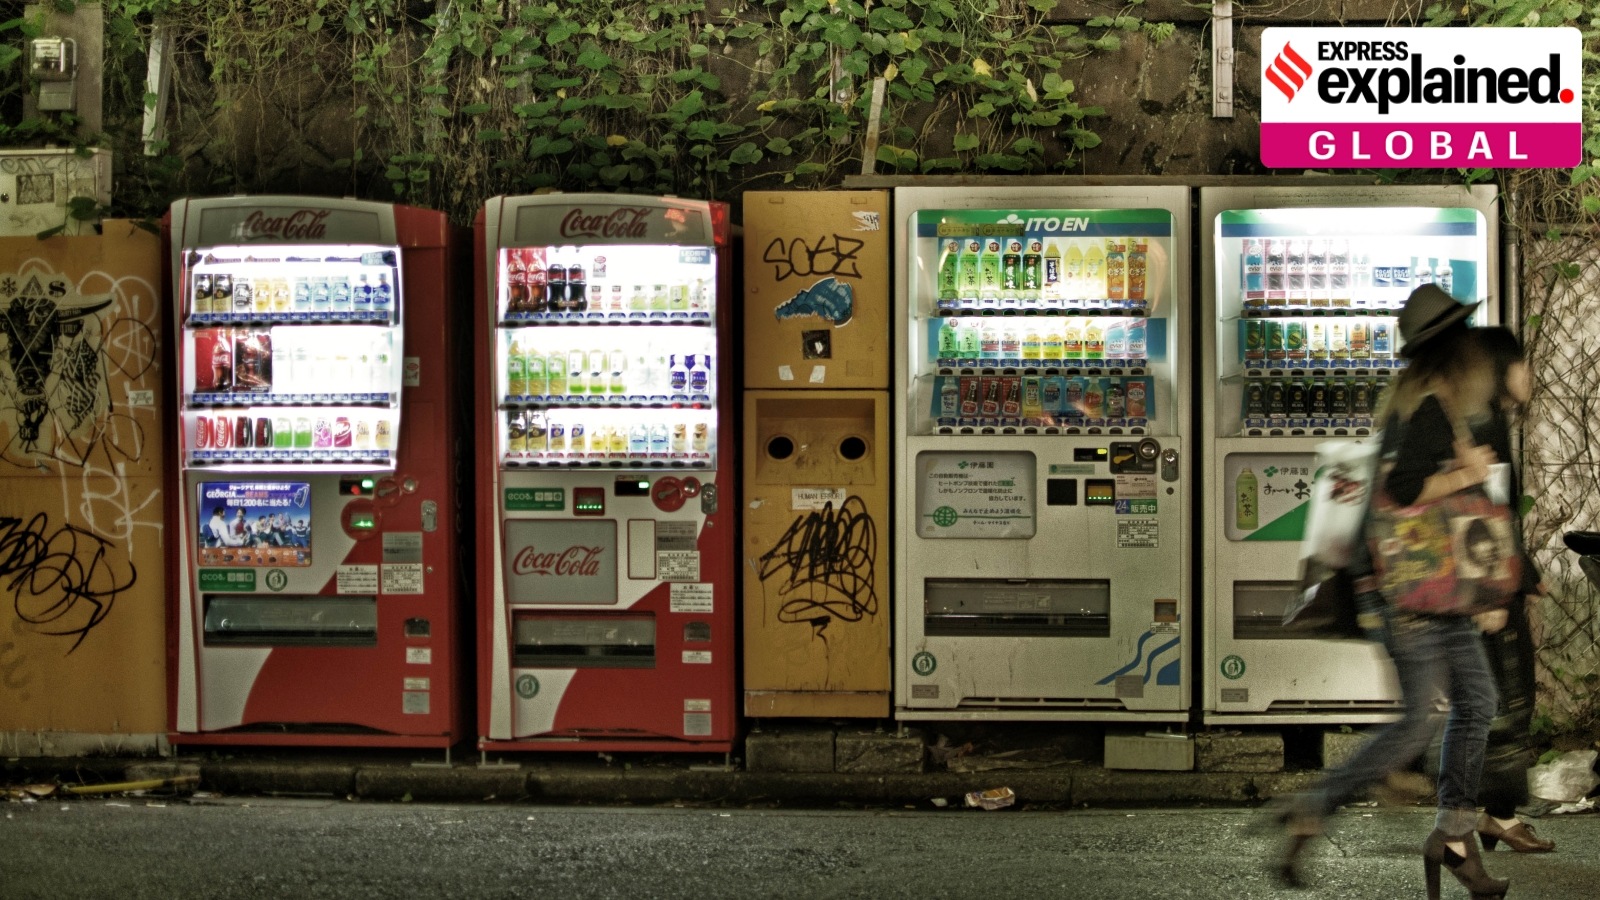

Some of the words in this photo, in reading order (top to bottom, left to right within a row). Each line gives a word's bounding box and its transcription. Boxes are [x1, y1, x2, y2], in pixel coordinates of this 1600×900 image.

[242, 209, 332, 240] Coca-Cola
[560, 207, 653, 239] Coca-Cola
[1025, 217, 1060, 232] ITO
[1062, 217, 1089, 232] EN
[970, 461, 994, 469] 伊藤園
[1280, 467, 1309, 476] 伊藤園
[1130, 504, 1156, 513] 販売中
[1240, 493, 1254, 516] お茶
[512, 544, 605, 577] Coca-Cola
